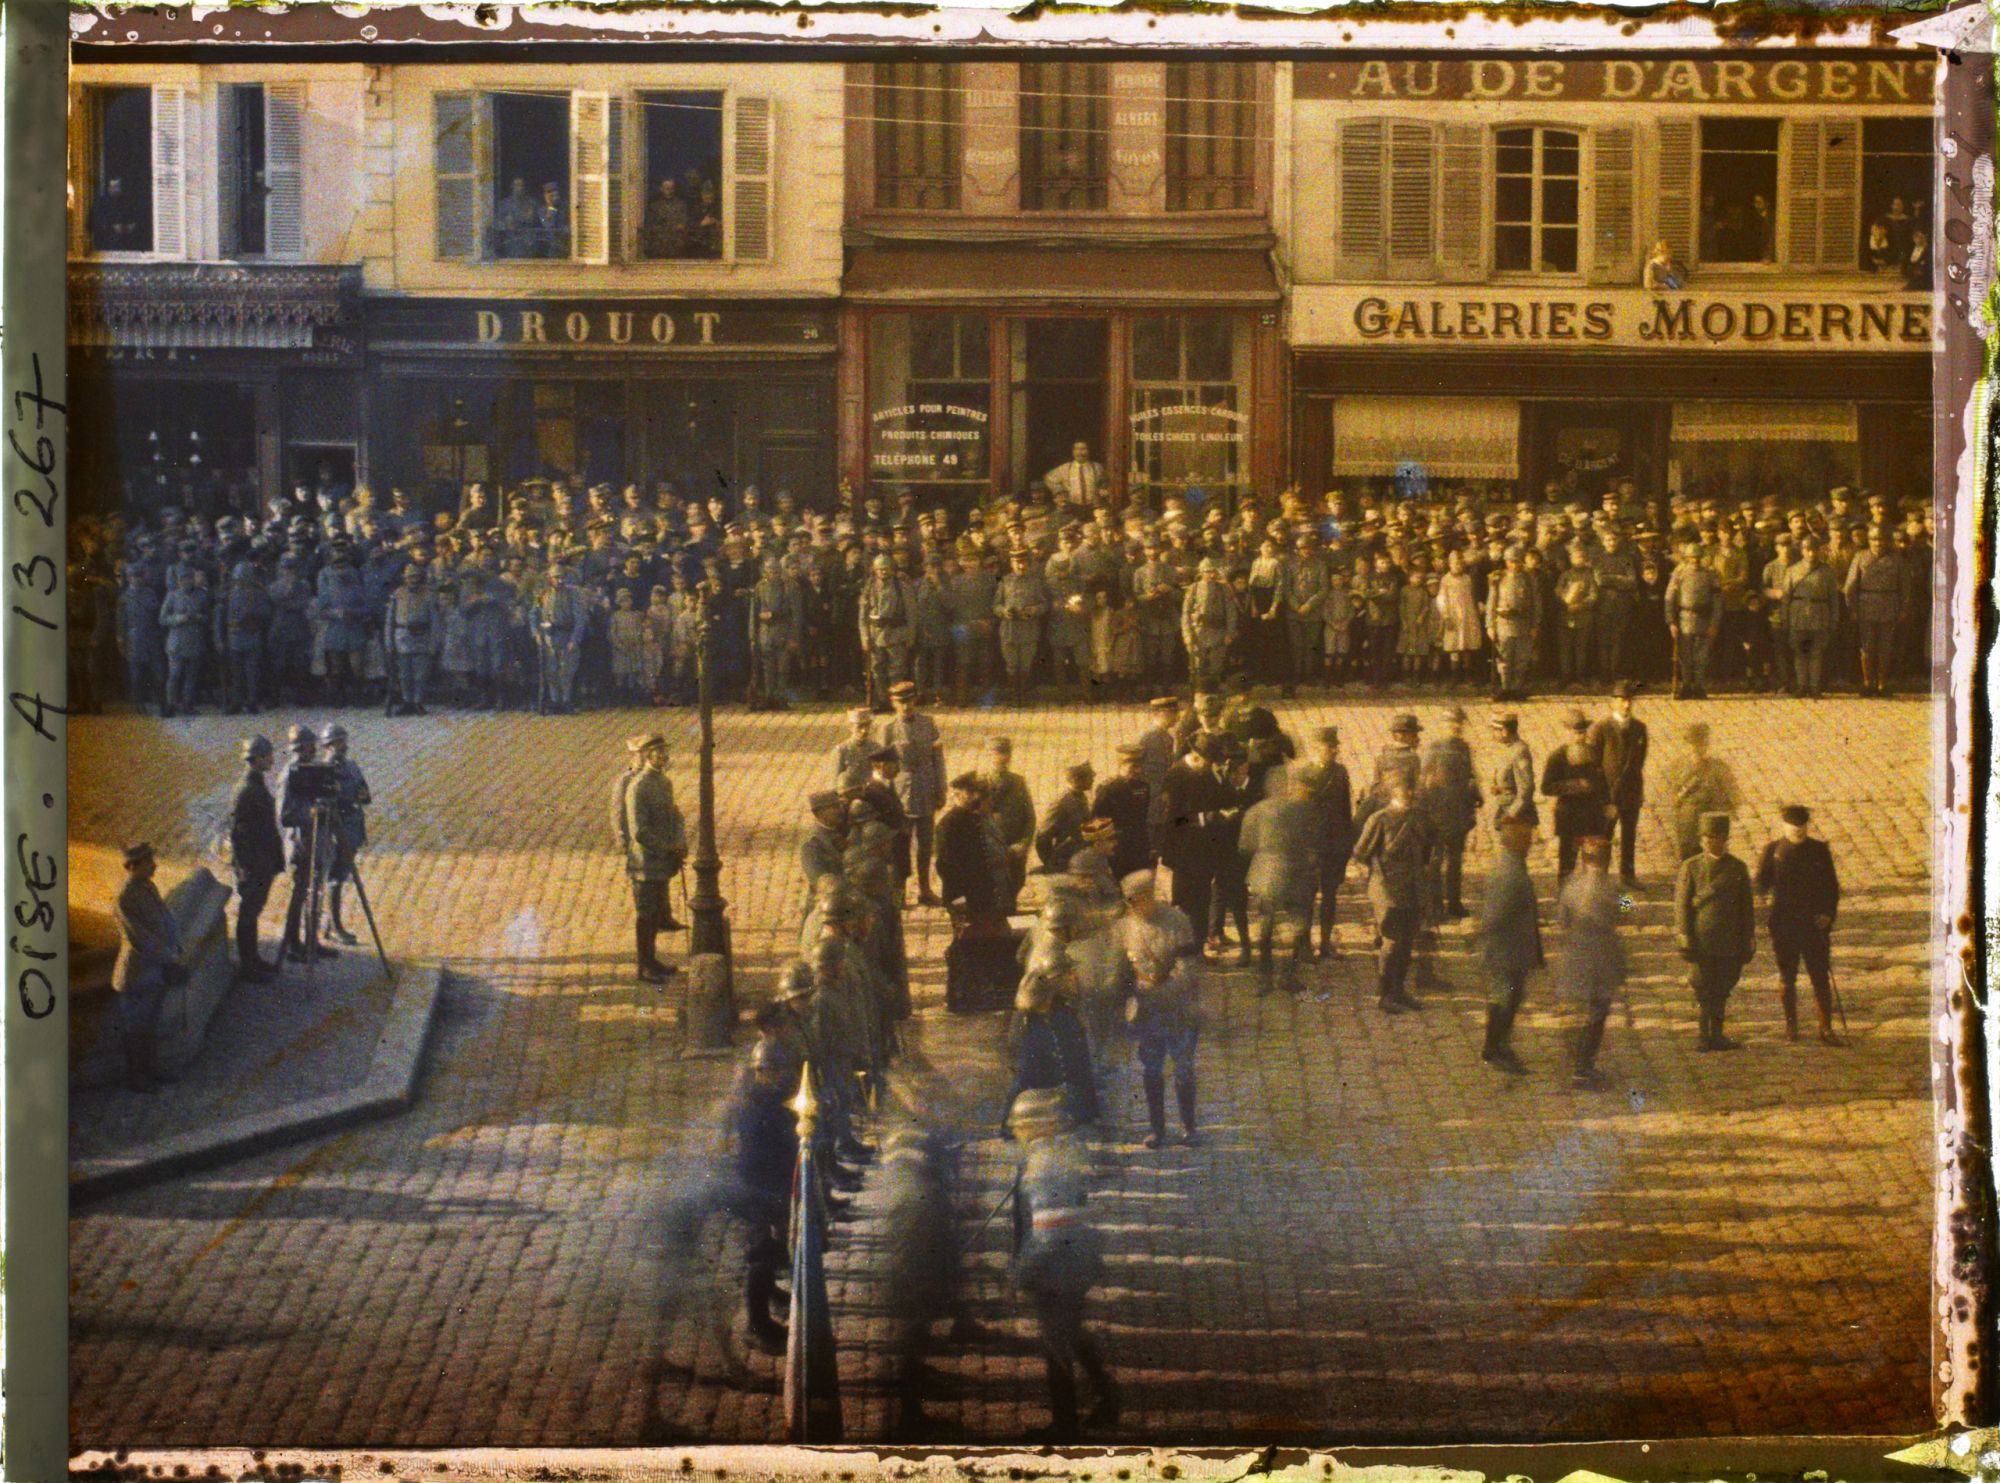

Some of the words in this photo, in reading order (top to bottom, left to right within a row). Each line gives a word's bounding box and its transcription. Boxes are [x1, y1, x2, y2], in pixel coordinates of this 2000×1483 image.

[1351, 60, 1440, 96] AU
[475, 310, 721, 344] DROUOT
[1353, 297, 1615, 338] GALERIES
[873, 404, 915, 422] ARTICLES
[919, 403, 943, 414] POUR
[946, 404, 988, 422] PEINTRES
[881, 430, 926, 440] PRODUITS
[930, 430, 980, 441] CHIMIQUES
[9, 690, 68, 742] A
